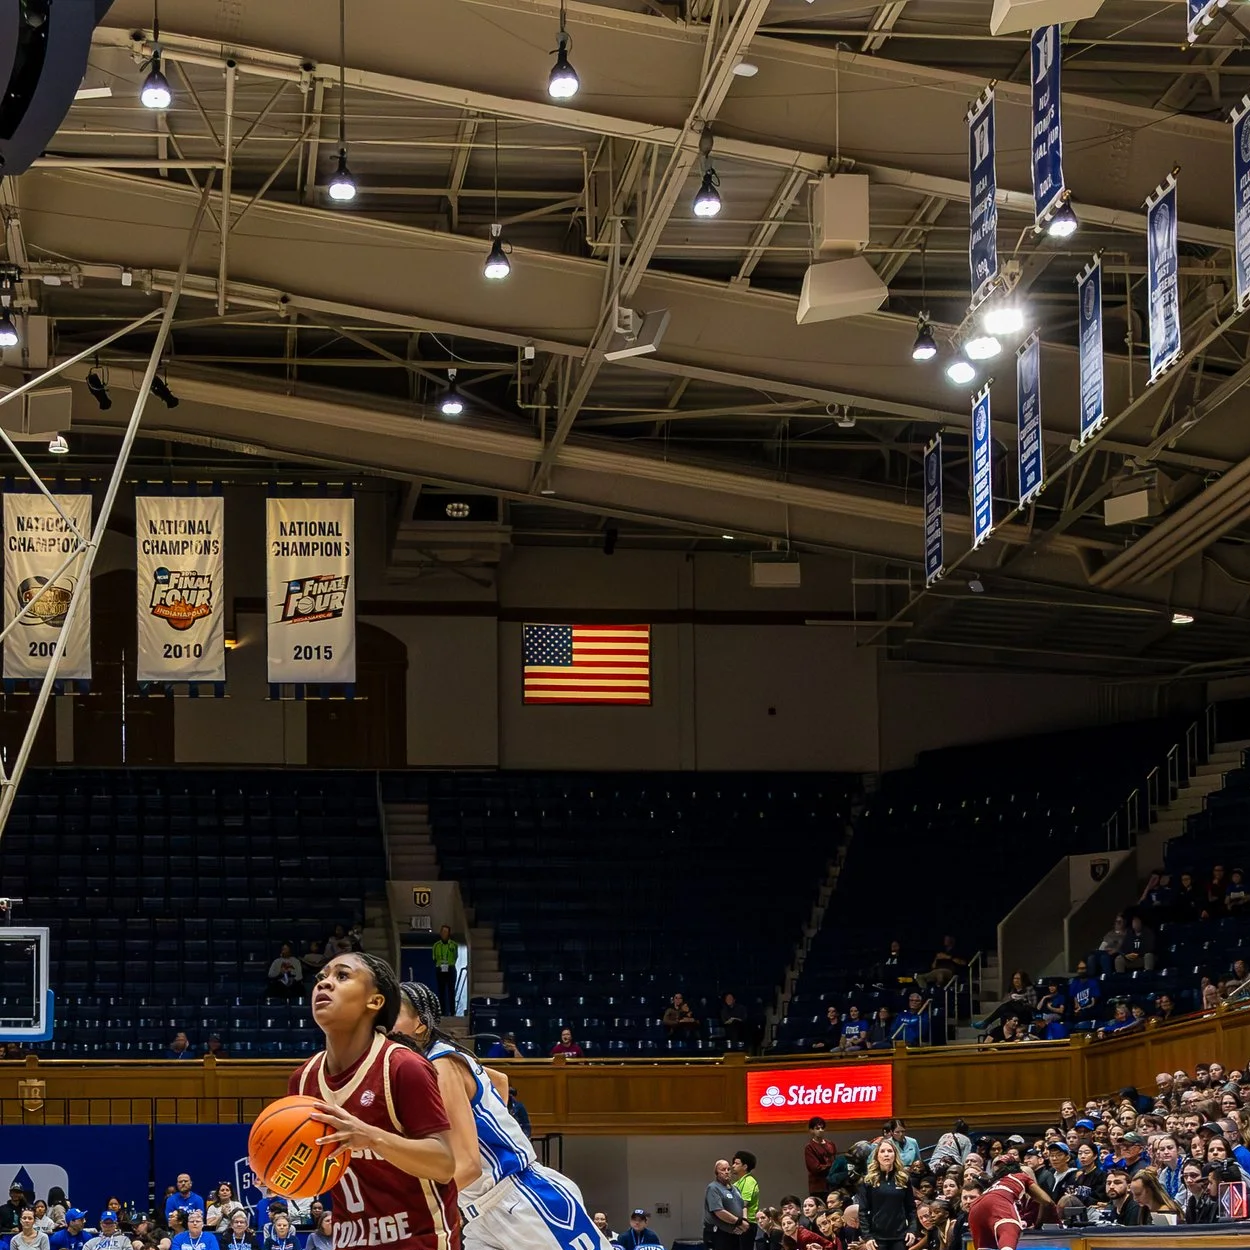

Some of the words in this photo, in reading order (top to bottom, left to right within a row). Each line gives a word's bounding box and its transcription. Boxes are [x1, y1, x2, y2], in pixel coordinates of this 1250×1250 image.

[149, 519, 212, 535] NATIONAL
[280, 521, 342, 537] NATIONAL
[142, 539, 219, 555] CHAMPIONS
[272, 541, 350, 557] CHAMPIONS
[169, 572, 211, 589] FINAL
[304, 578, 346, 596] FINAL
[152, 583, 210, 608] FOUR
[163, 643, 203, 659] 2010
[293, 645, 333, 660] 2015
[415, 892, 429, 905] 10
[274, 1142, 313, 1190] ELITE
[332, 1211, 412, 1250] COLLEGE
